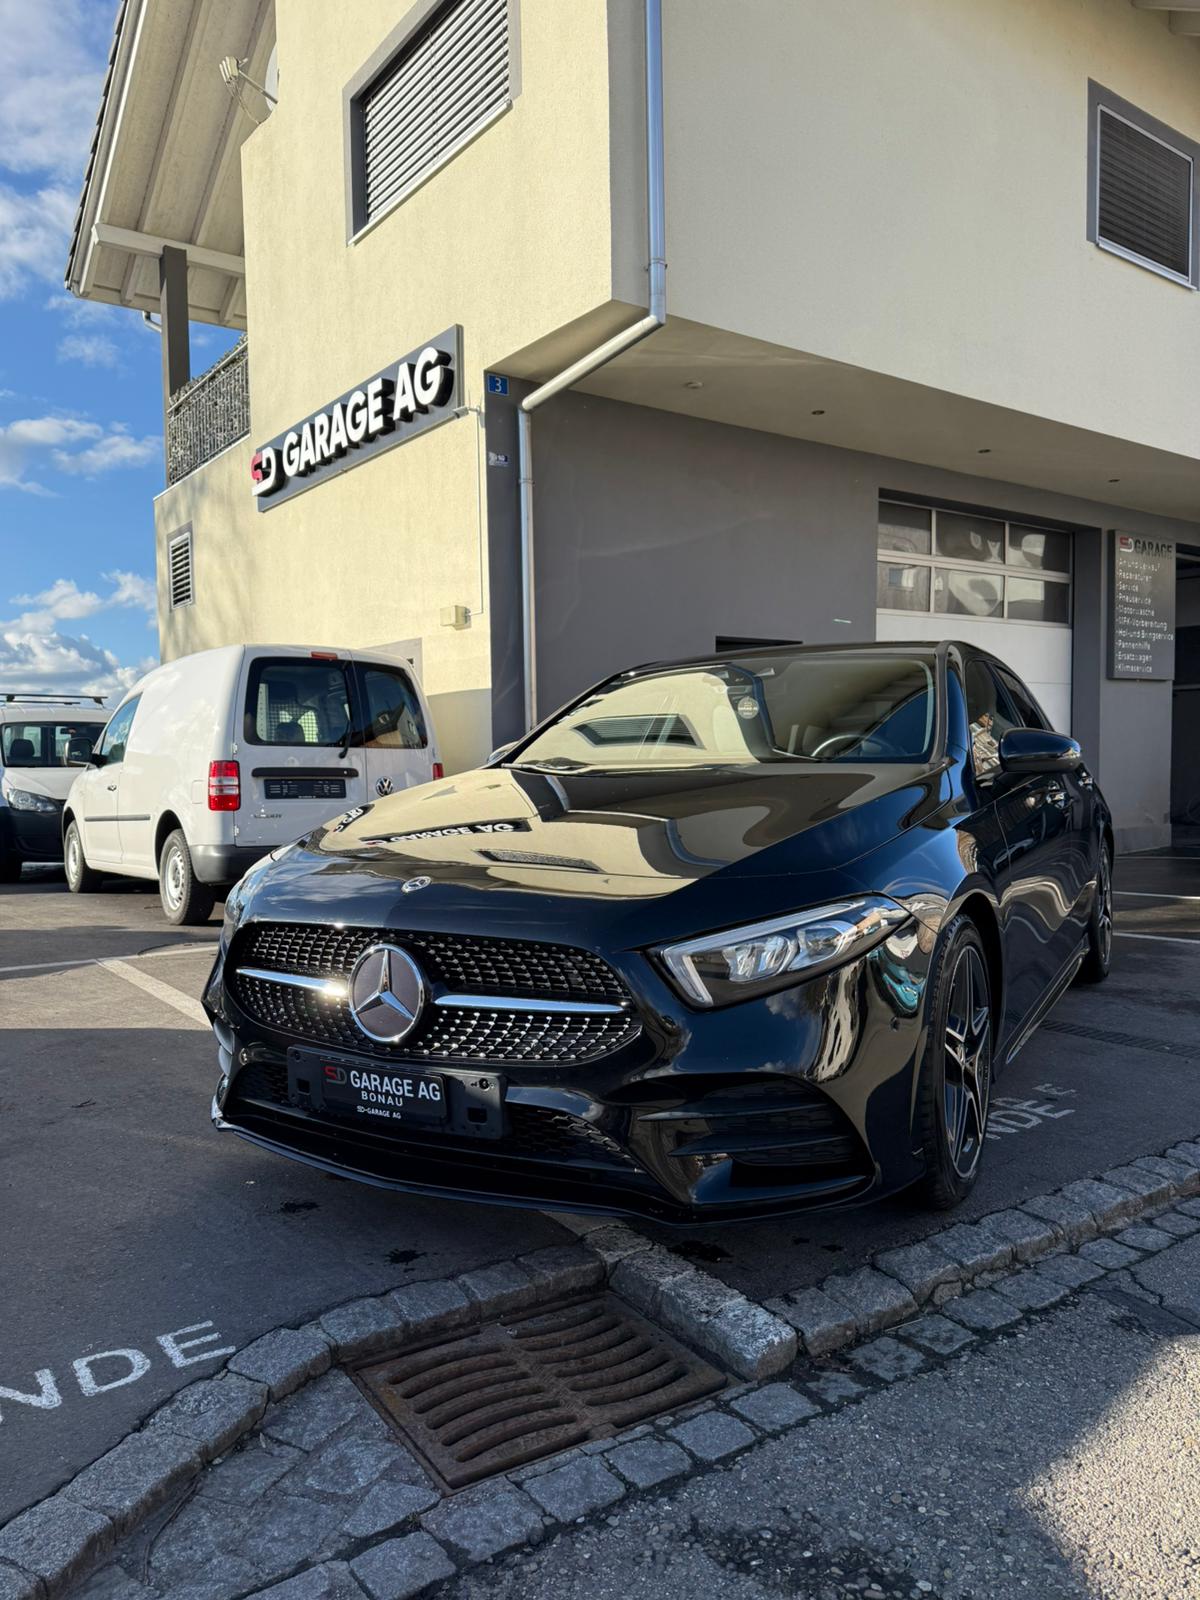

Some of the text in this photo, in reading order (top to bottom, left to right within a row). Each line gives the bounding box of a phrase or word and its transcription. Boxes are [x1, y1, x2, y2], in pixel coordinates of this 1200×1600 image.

[494, 377, 502, 392] 3
[282, 377, 384, 478] GARAGE
[393, 346, 443, 421] AG
[1134, 539, 1174, 559] GARAGE
[350, 1070, 414, 1098] GARAGE
[418, 1081, 441, 1101] AG
[361, 1090, 404, 1107] BONAU
